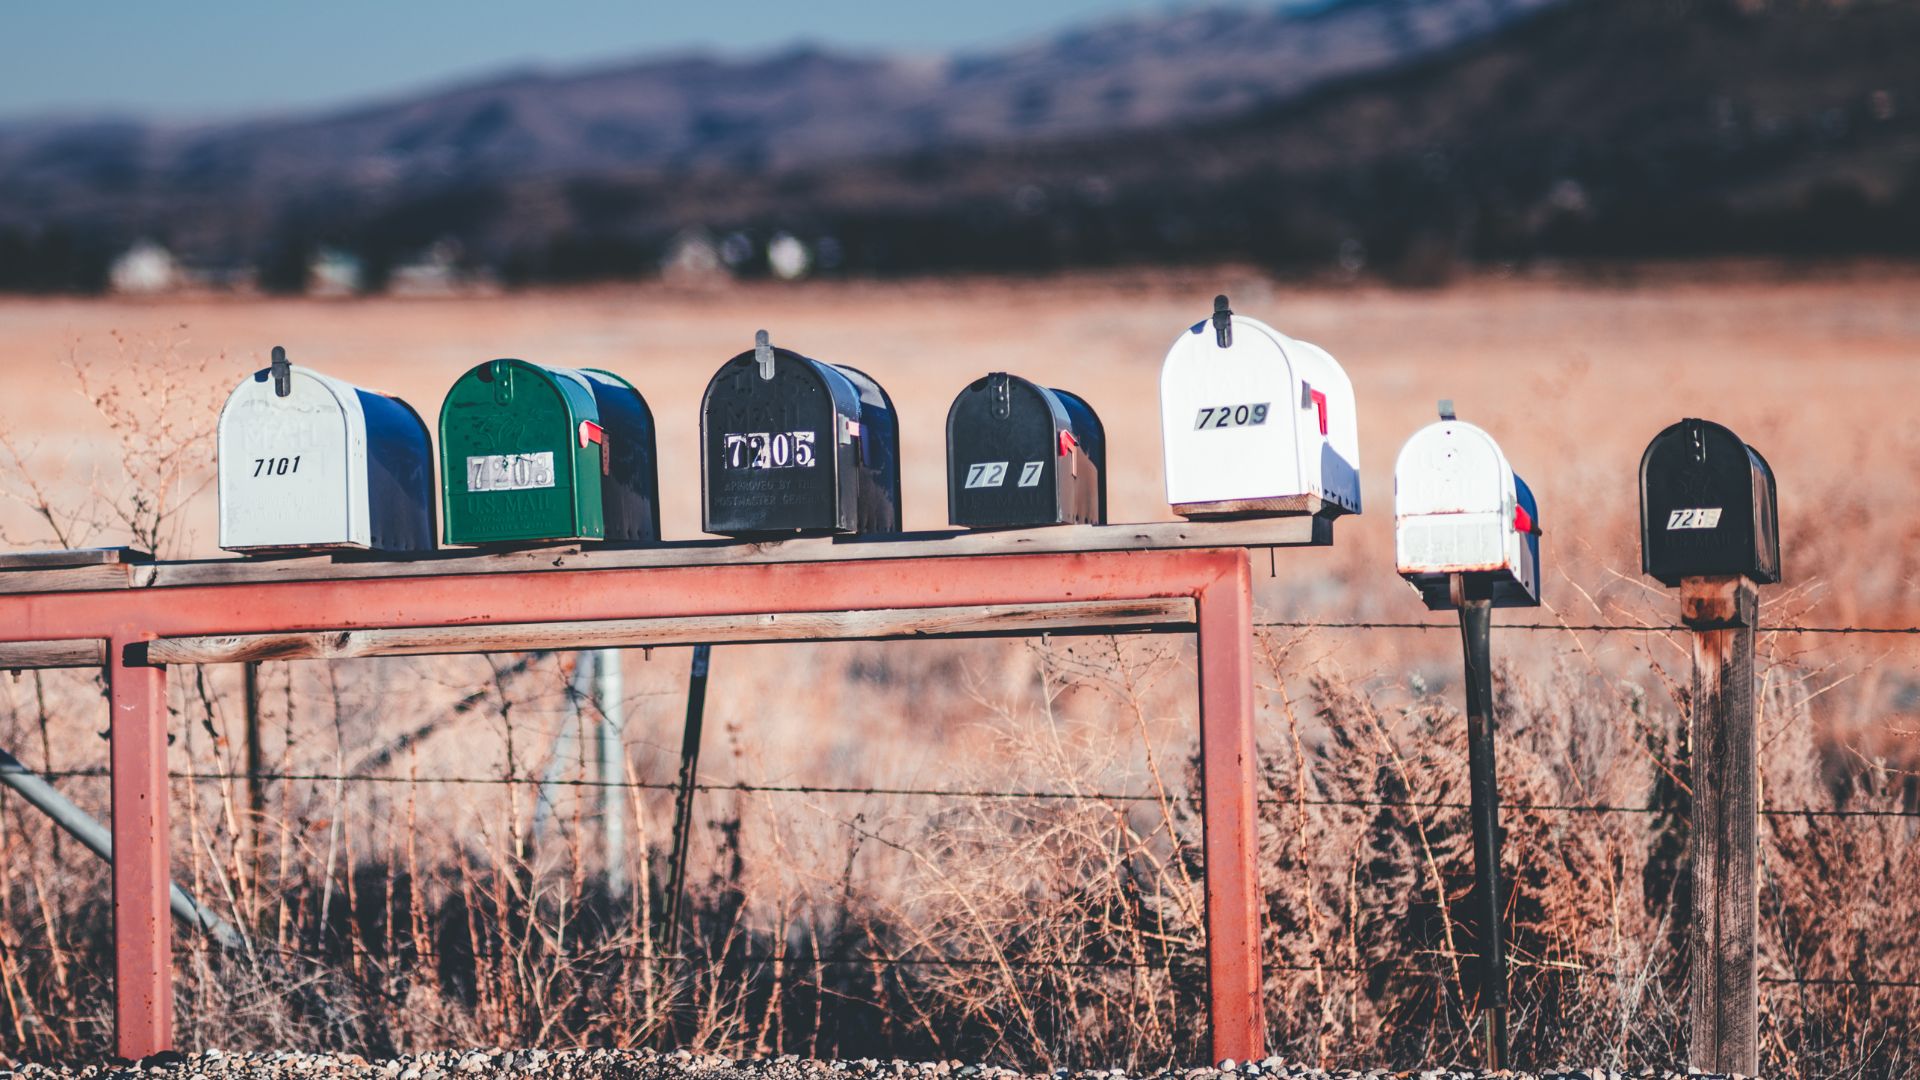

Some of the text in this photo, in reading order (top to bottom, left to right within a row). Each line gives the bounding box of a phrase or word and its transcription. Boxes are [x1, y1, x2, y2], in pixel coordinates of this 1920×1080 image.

[1198, 403, 1267, 430] 7209
[727, 433, 812, 468] 7205
[253, 455, 301, 478] 7101
[470, 455, 552, 490] 7203
[504, 492, 557, 513] MAIL
